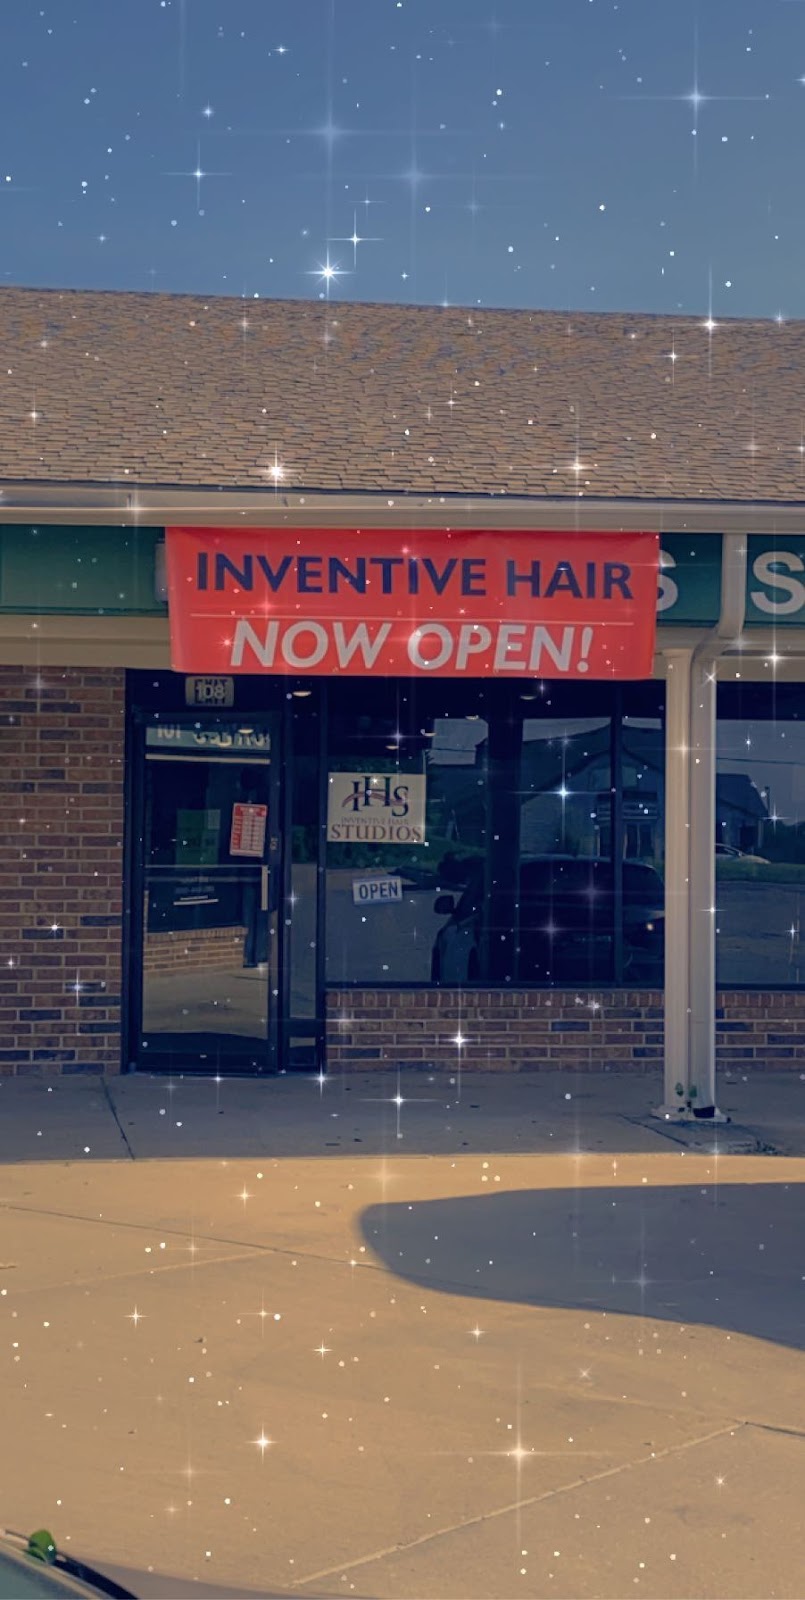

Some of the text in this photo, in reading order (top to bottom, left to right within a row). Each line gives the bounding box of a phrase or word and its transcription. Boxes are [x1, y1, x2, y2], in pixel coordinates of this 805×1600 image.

[197, 552, 486, 596] INVENTIVE
[506, 560, 633, 600] HAIR
[230, 620, 593, 673] NOW OPEN!
[195, 681, 226, 701] 108
[349, 775, 409, 817] IHS
[331, 824, 422, 841] STUDIOS
[359, 881, 398, 900] OPEN
